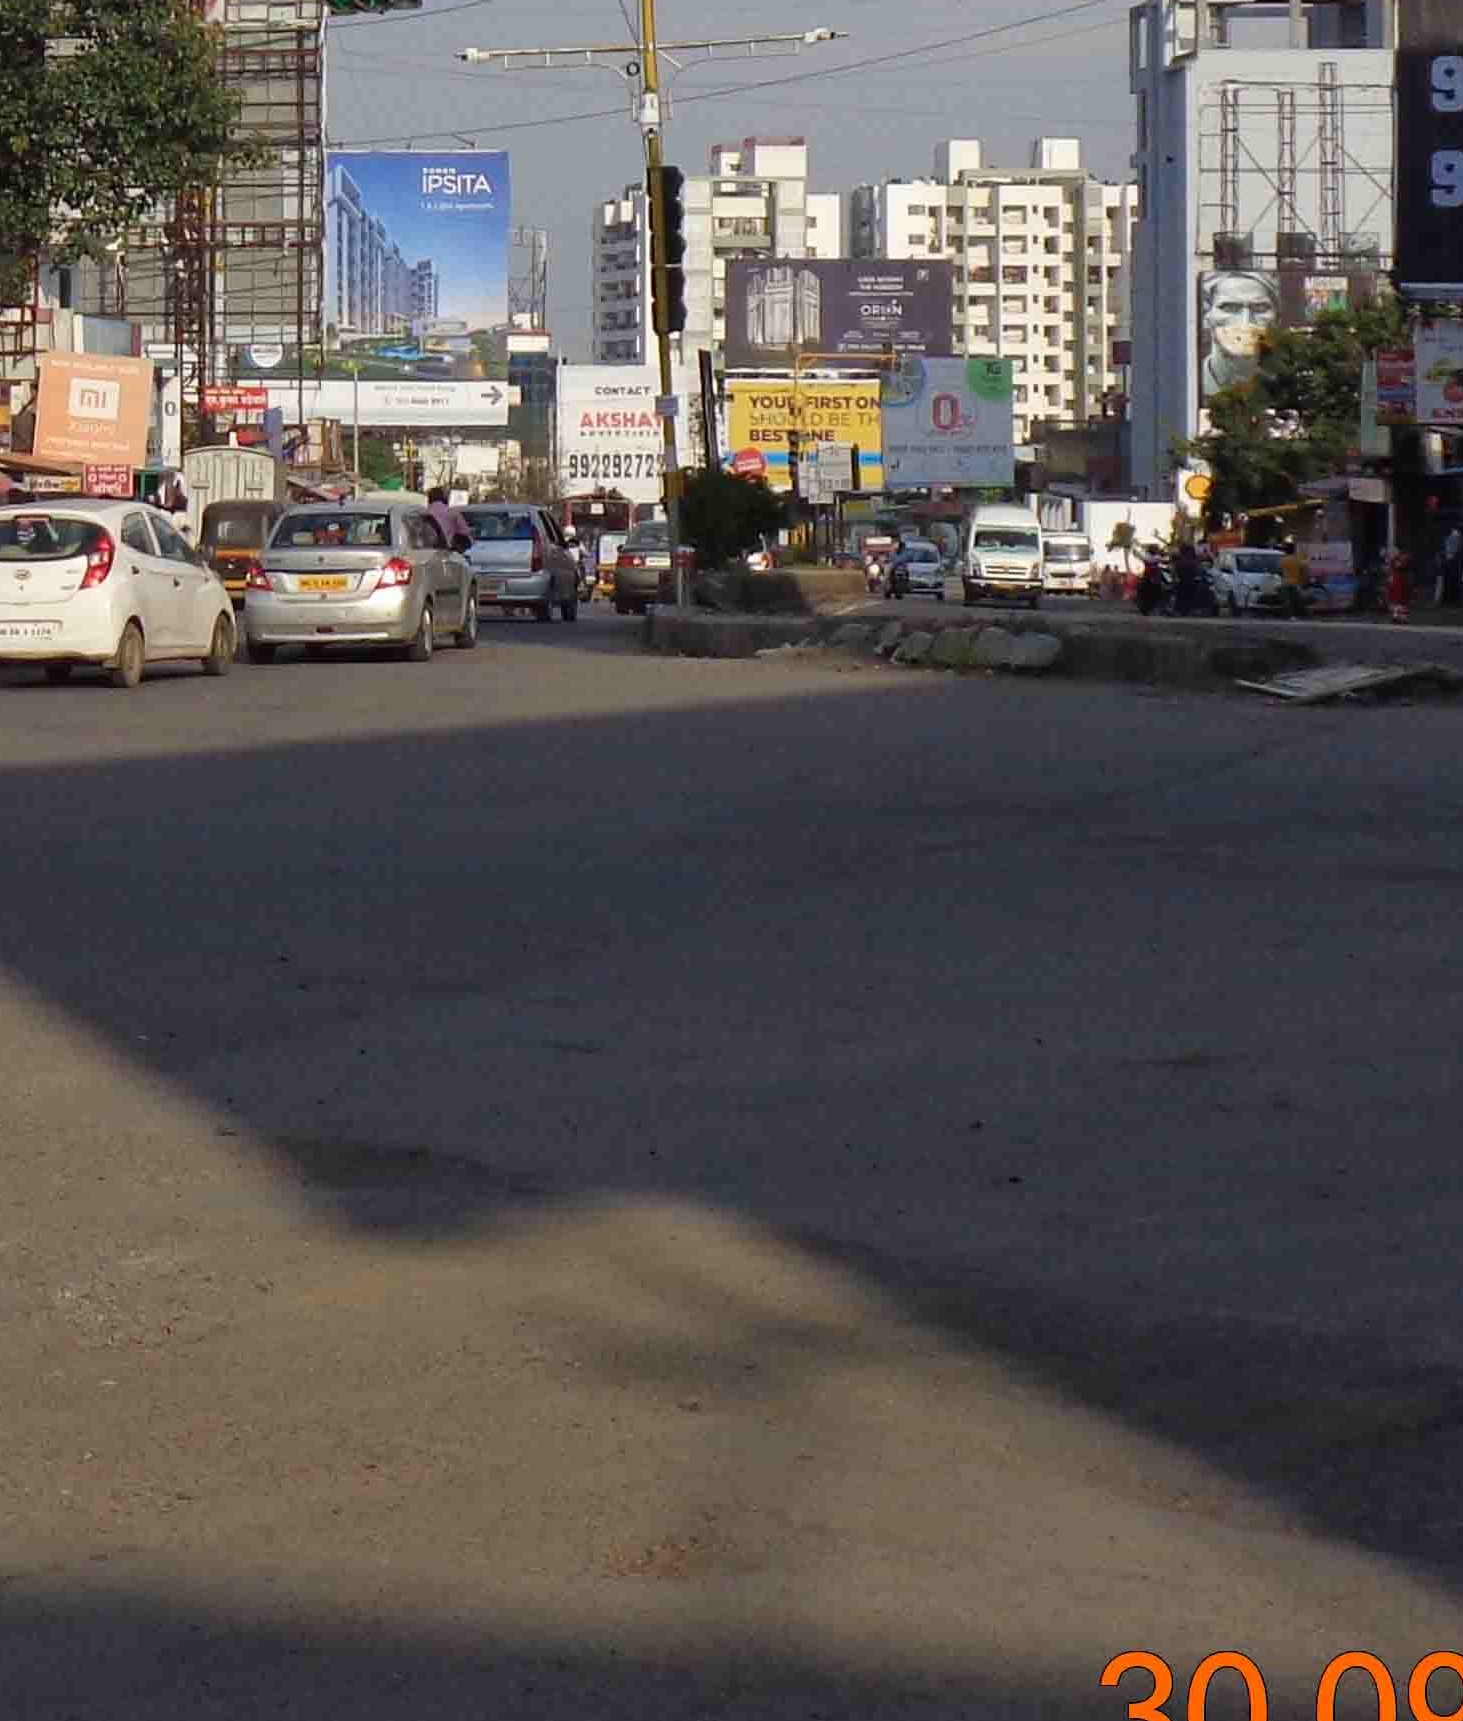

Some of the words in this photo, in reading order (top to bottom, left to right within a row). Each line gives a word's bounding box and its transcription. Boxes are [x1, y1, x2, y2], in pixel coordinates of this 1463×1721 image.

[422, 174, 492, 194] IPSITA
[594, 386, 651, 396] CONTACT
[856, 396, 881, 409] ON
[828, 412, 850, 427] BE
[856, 412, 881, 427] TH
